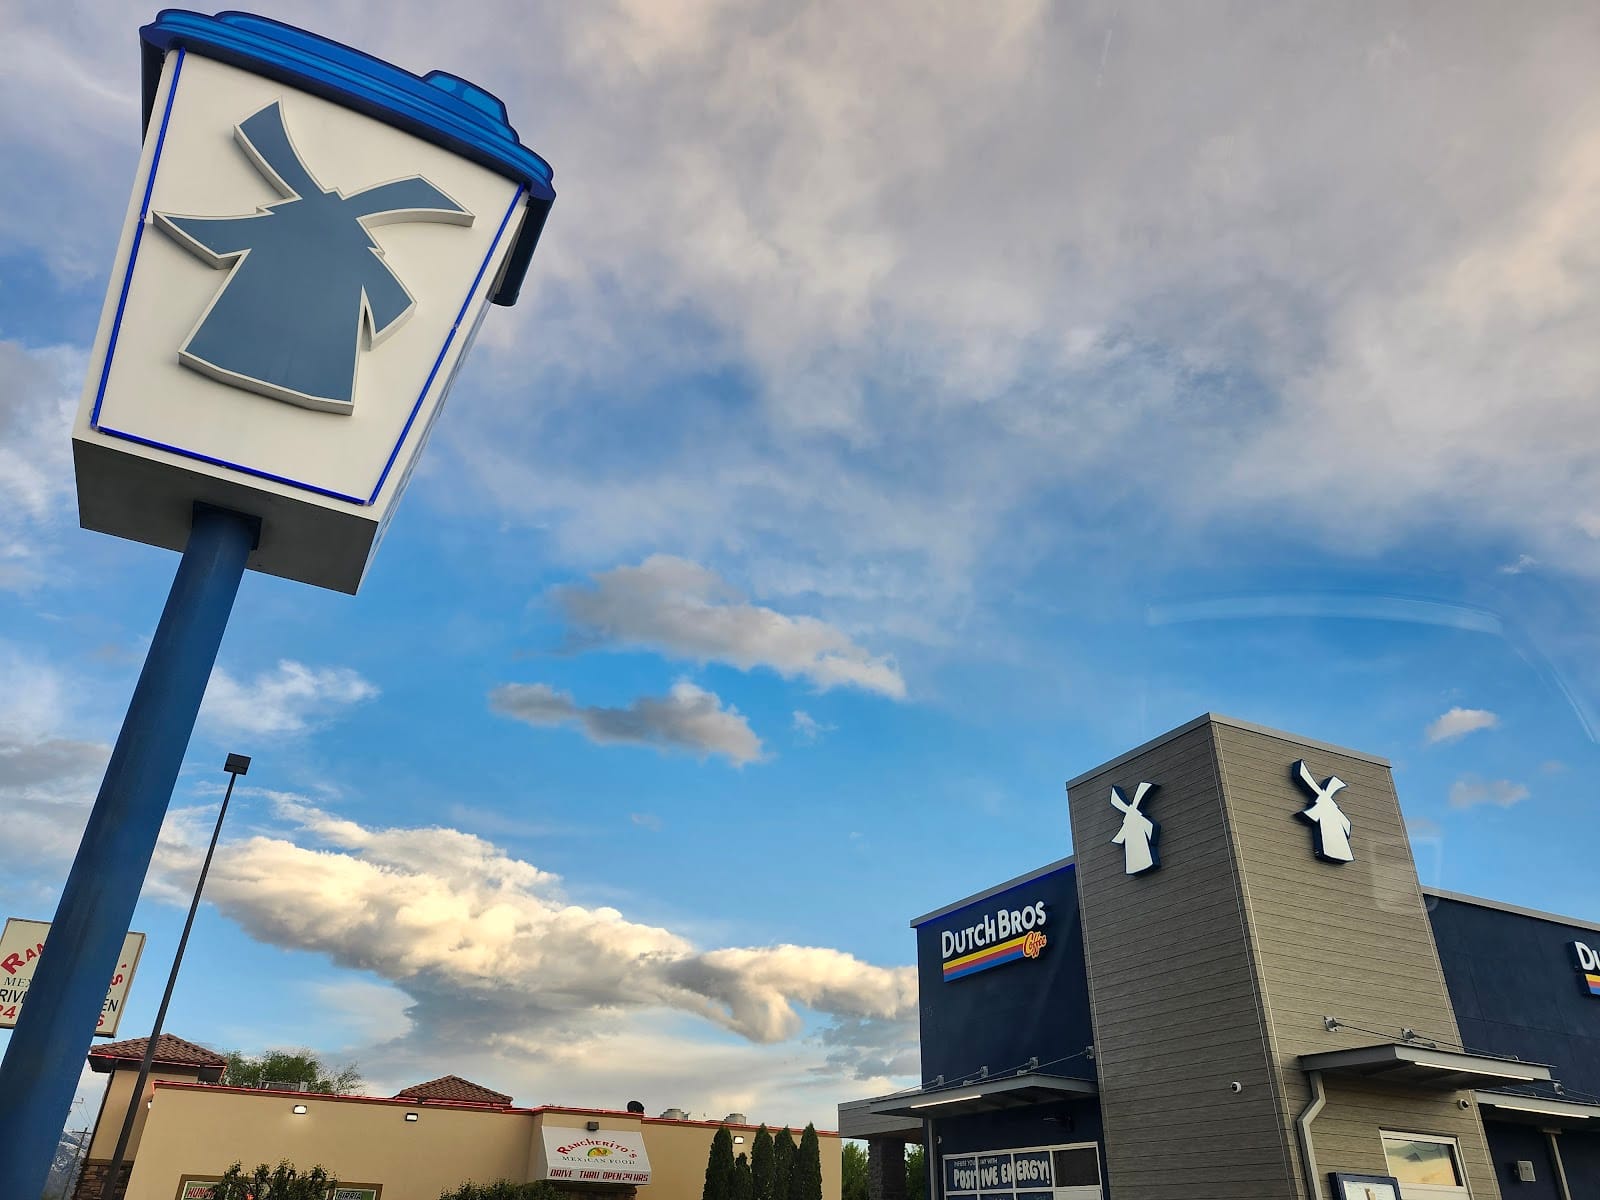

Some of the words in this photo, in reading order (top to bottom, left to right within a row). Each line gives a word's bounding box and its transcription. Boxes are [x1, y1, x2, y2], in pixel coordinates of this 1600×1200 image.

[997, 901, 1047, 940] BROS
[561, 1156, 606, 1164] MEXICAN
[550, 1169, 573, 1178] DRIVE
[579, 1170, 600, 1179] THRU
[602, 1171, 622, 1180] OPEN
[622, 1173, 633, 1181] 24
[633, 1174, 649, 1182] HRS
